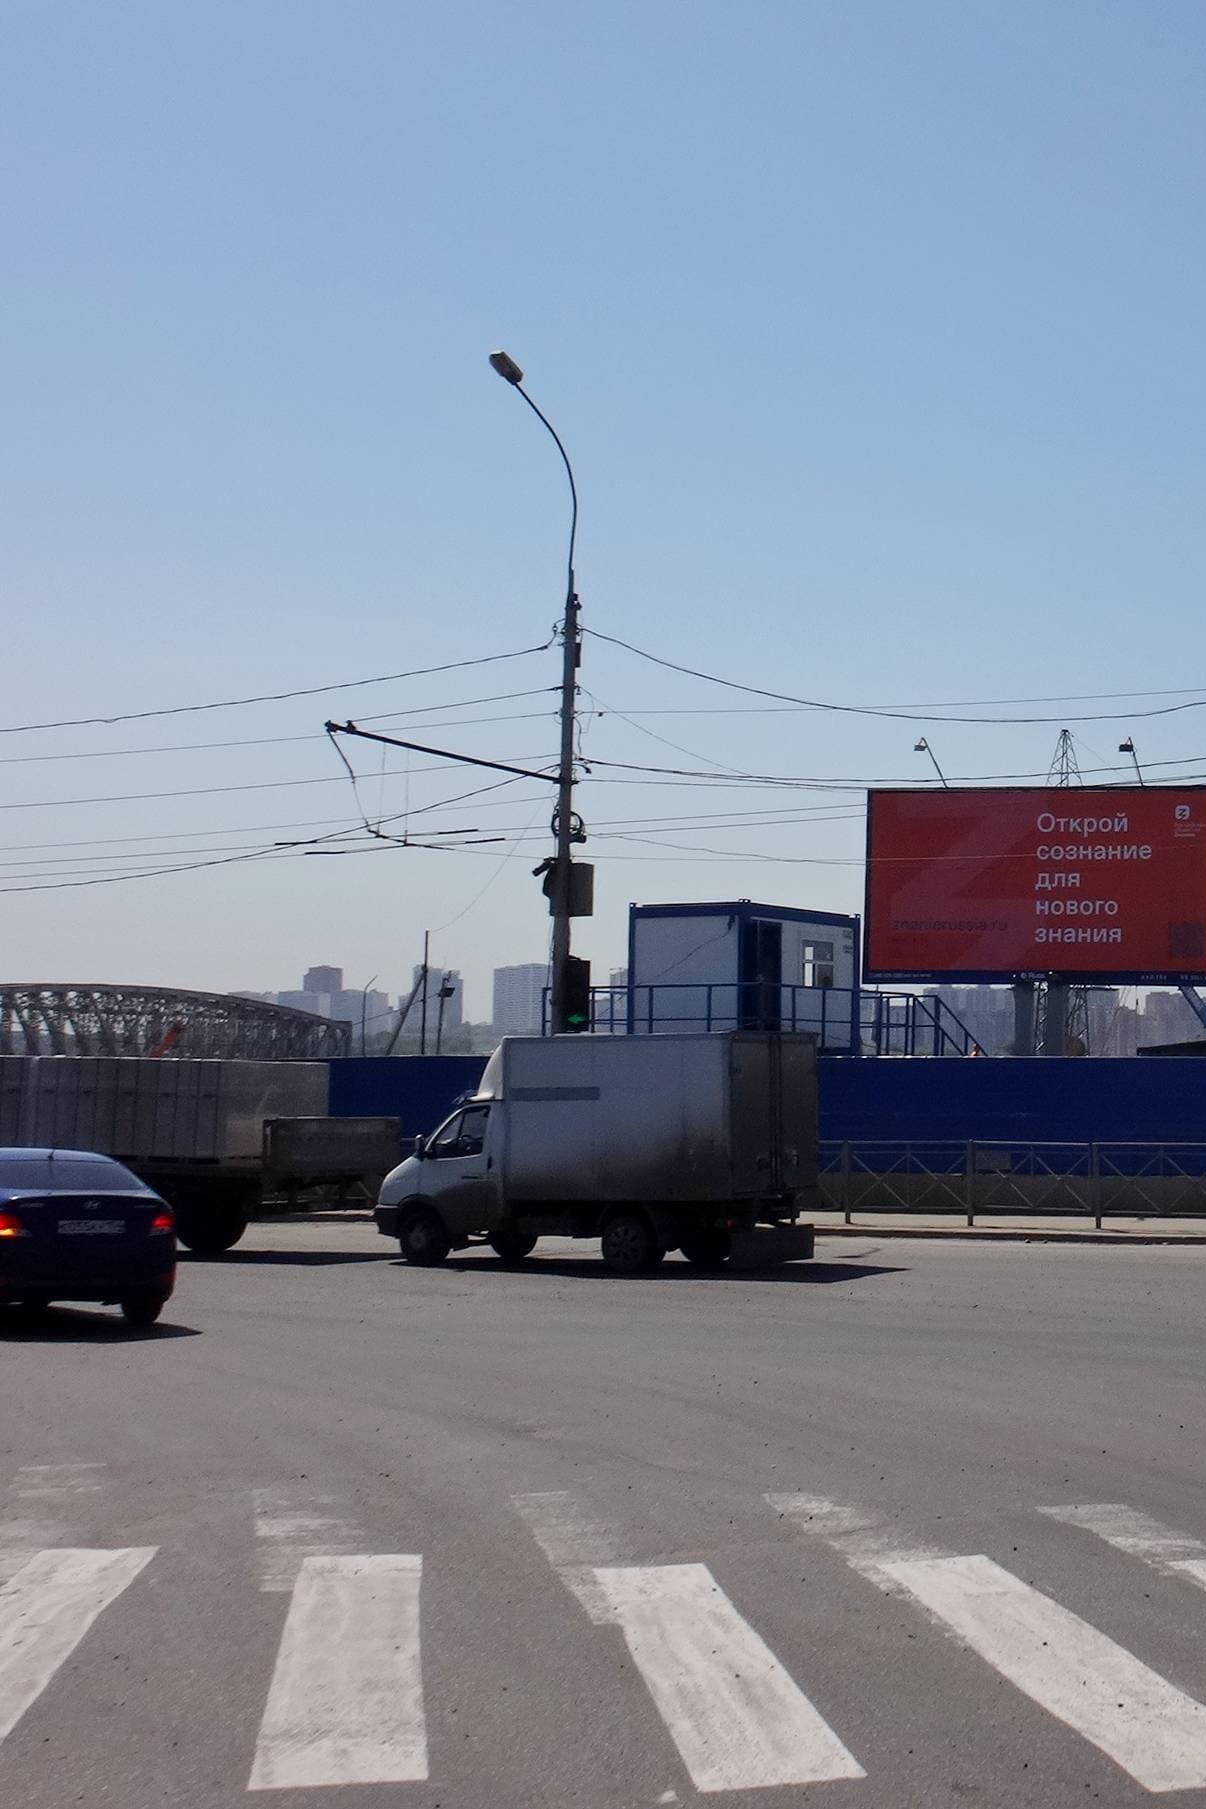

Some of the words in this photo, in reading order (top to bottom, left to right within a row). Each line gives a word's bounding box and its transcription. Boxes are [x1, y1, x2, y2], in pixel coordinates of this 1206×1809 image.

[1037, 812, 1128, 837] Открой
[1037, 845, 1152, 860] сознание
[1035, 873, 1081, 891] для
[1036, 900, 1119, 915] нового
[1035, 927, 1122, 943] знания
